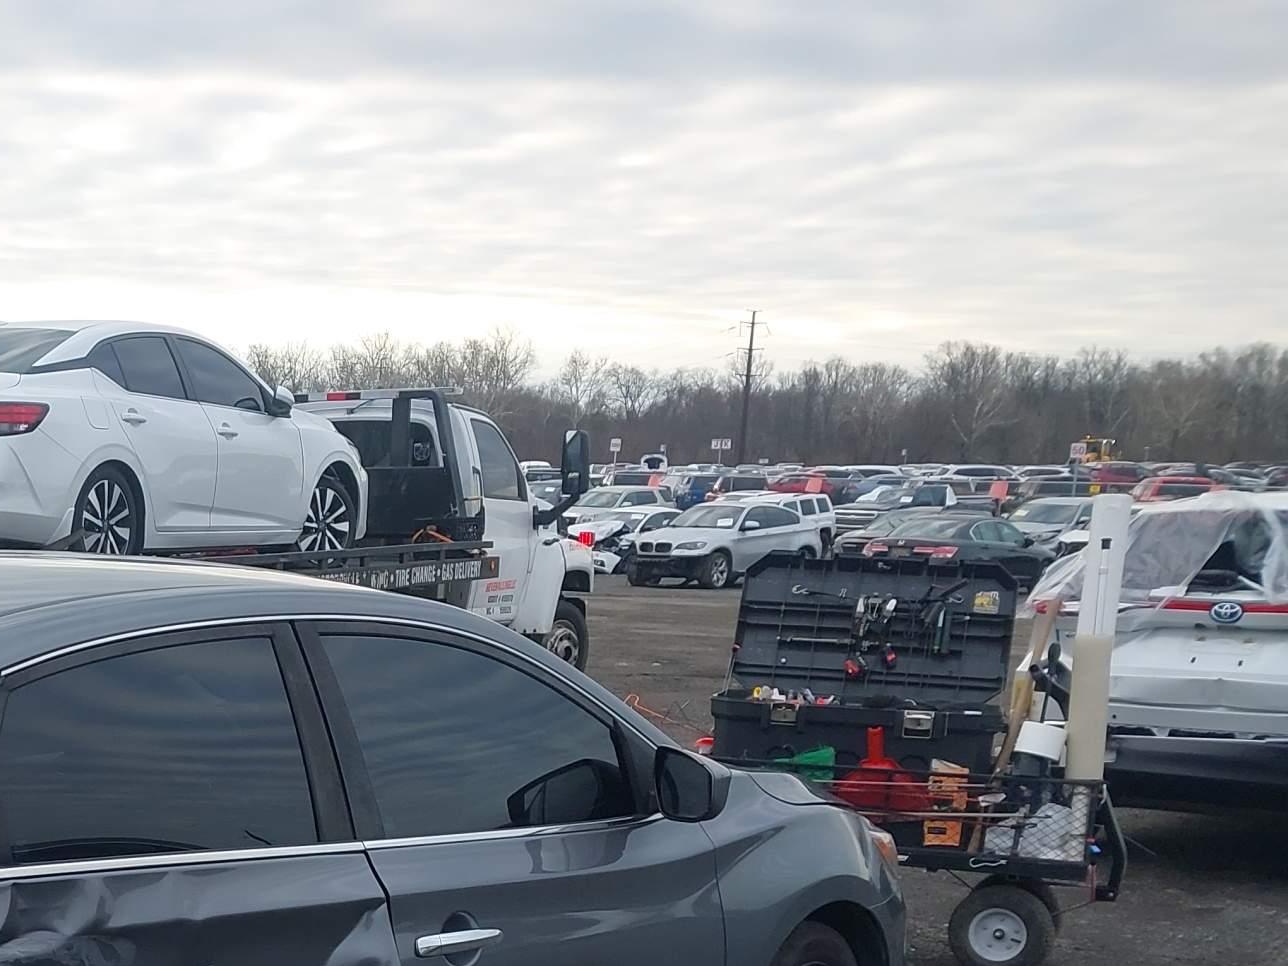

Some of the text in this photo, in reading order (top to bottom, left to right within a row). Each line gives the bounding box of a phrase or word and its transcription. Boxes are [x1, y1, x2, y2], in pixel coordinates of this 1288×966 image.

[395, 568, 410, 588] TIRE
[411, 564, 436, 584] CHANGE
[441, 562, 454, 581] GAS
[454, 560, 481, 580] DELIVERY
